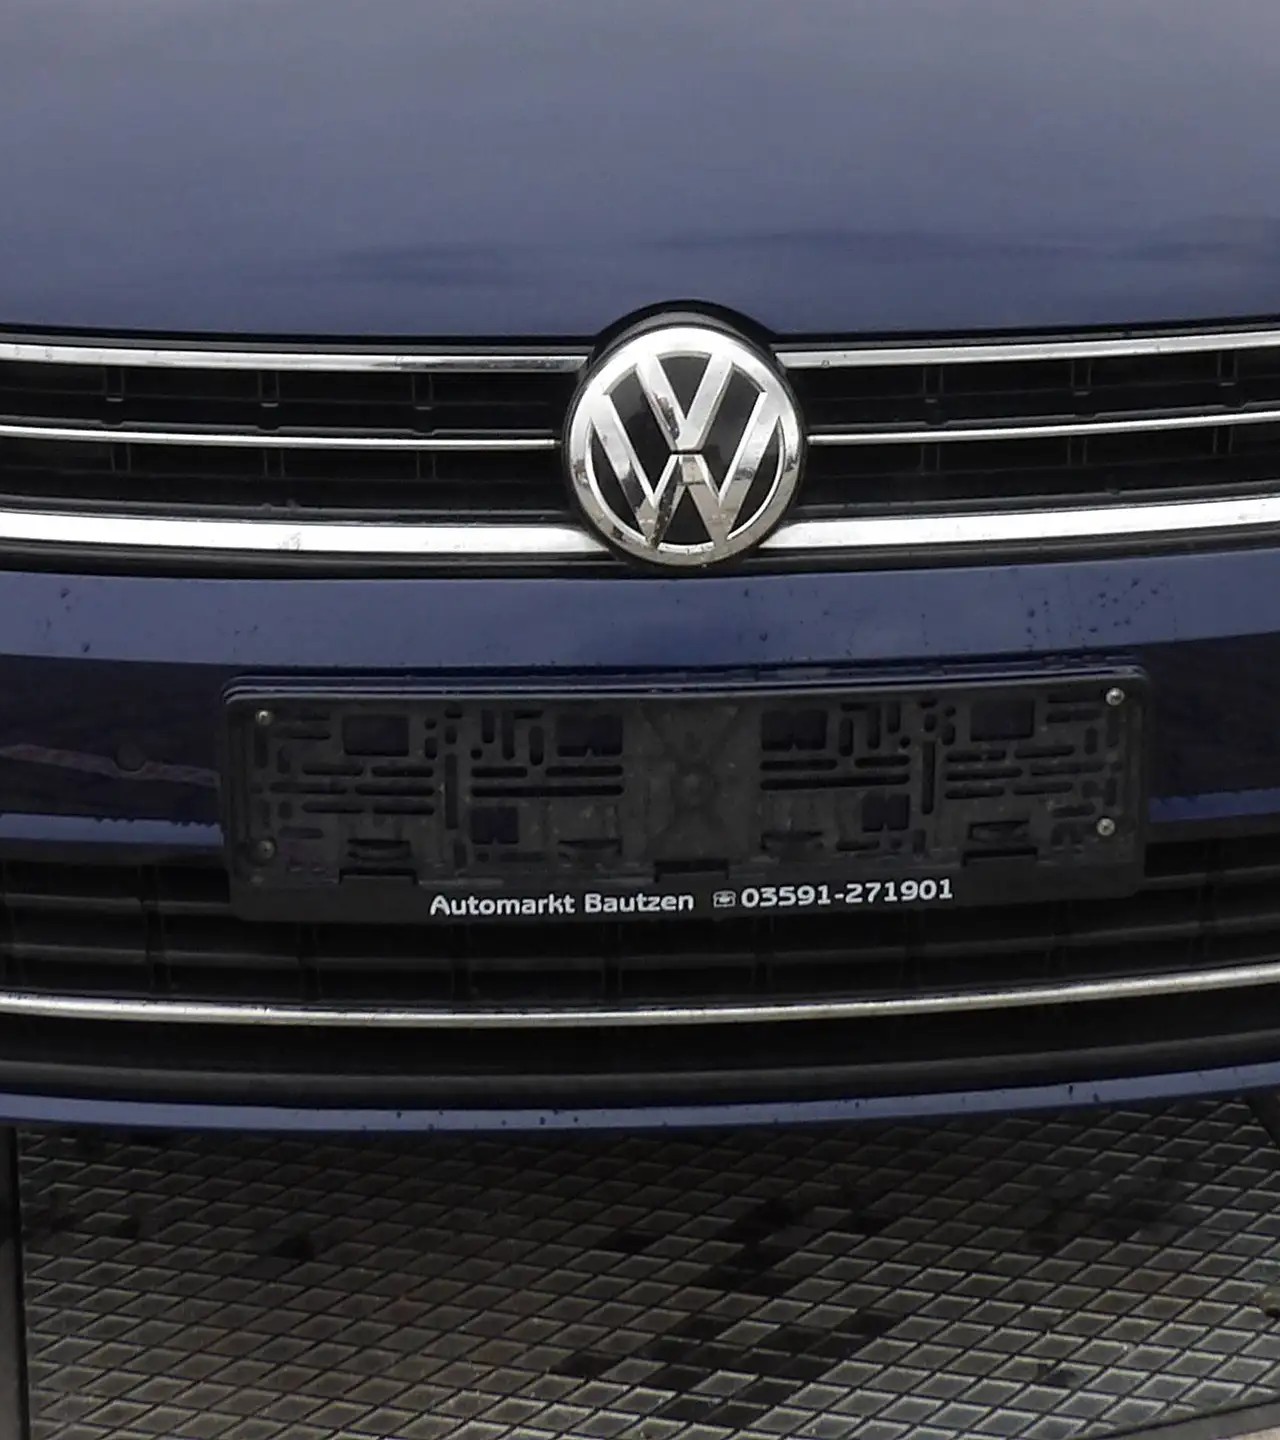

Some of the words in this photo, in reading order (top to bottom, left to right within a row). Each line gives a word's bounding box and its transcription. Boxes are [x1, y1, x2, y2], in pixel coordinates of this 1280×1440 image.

[576, 334, 795, 559] VW
[429, 893, 576, 916] Automarkt
[584, 892, 695, 914] Bautzen
[740, 878, 954, 908] 03591-271901
